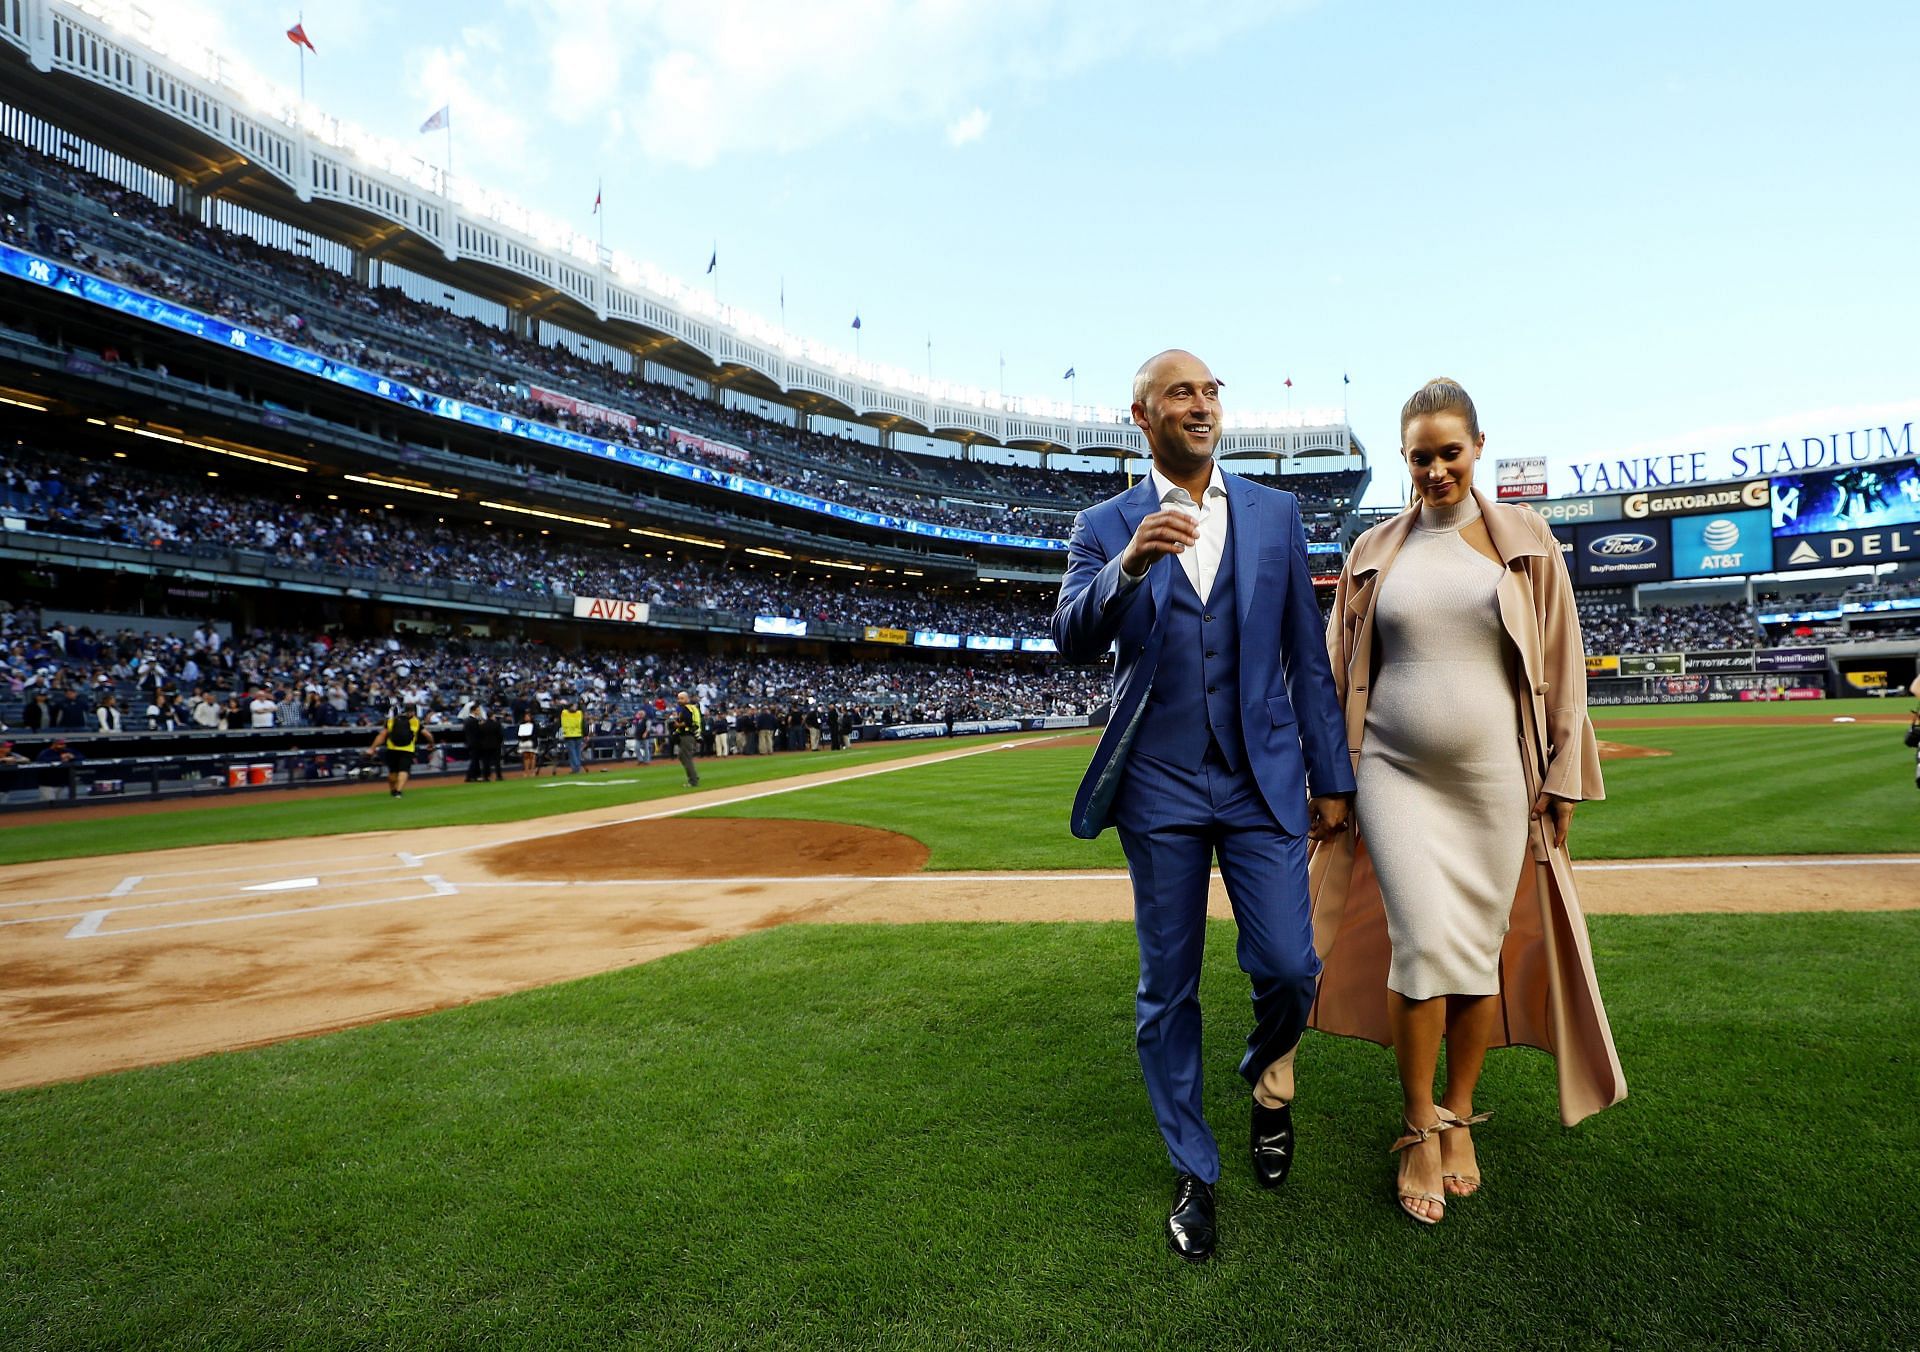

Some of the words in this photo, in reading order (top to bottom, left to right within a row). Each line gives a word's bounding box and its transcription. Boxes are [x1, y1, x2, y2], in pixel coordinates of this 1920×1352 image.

[1568, 452, 1707, 494] YANKEE
[1732, 422, 1913, 477] STADIUM
[1499, 459, 1546, 469] ARMITRON
[1500, 484, 1545, 494] ARMITRON
[1650, 490, 1741, 512] GATORADE
[1601, 536, 1645, 554] Ford
[1830, 528, 1920, 559] DEL
[1700, 553, 1744, 570] AT&T
[1590, 562, 1657, 573] BuyFordNow.com
[588, 599, 637, 621] AVIS
[1774, 653, 1825, 664] HotelTonight
[1587, 695, 1621, 705] StubHub
[1623, 695, 1659, 704] StubHub
[1661, 693, 1699, 703] StubHub
